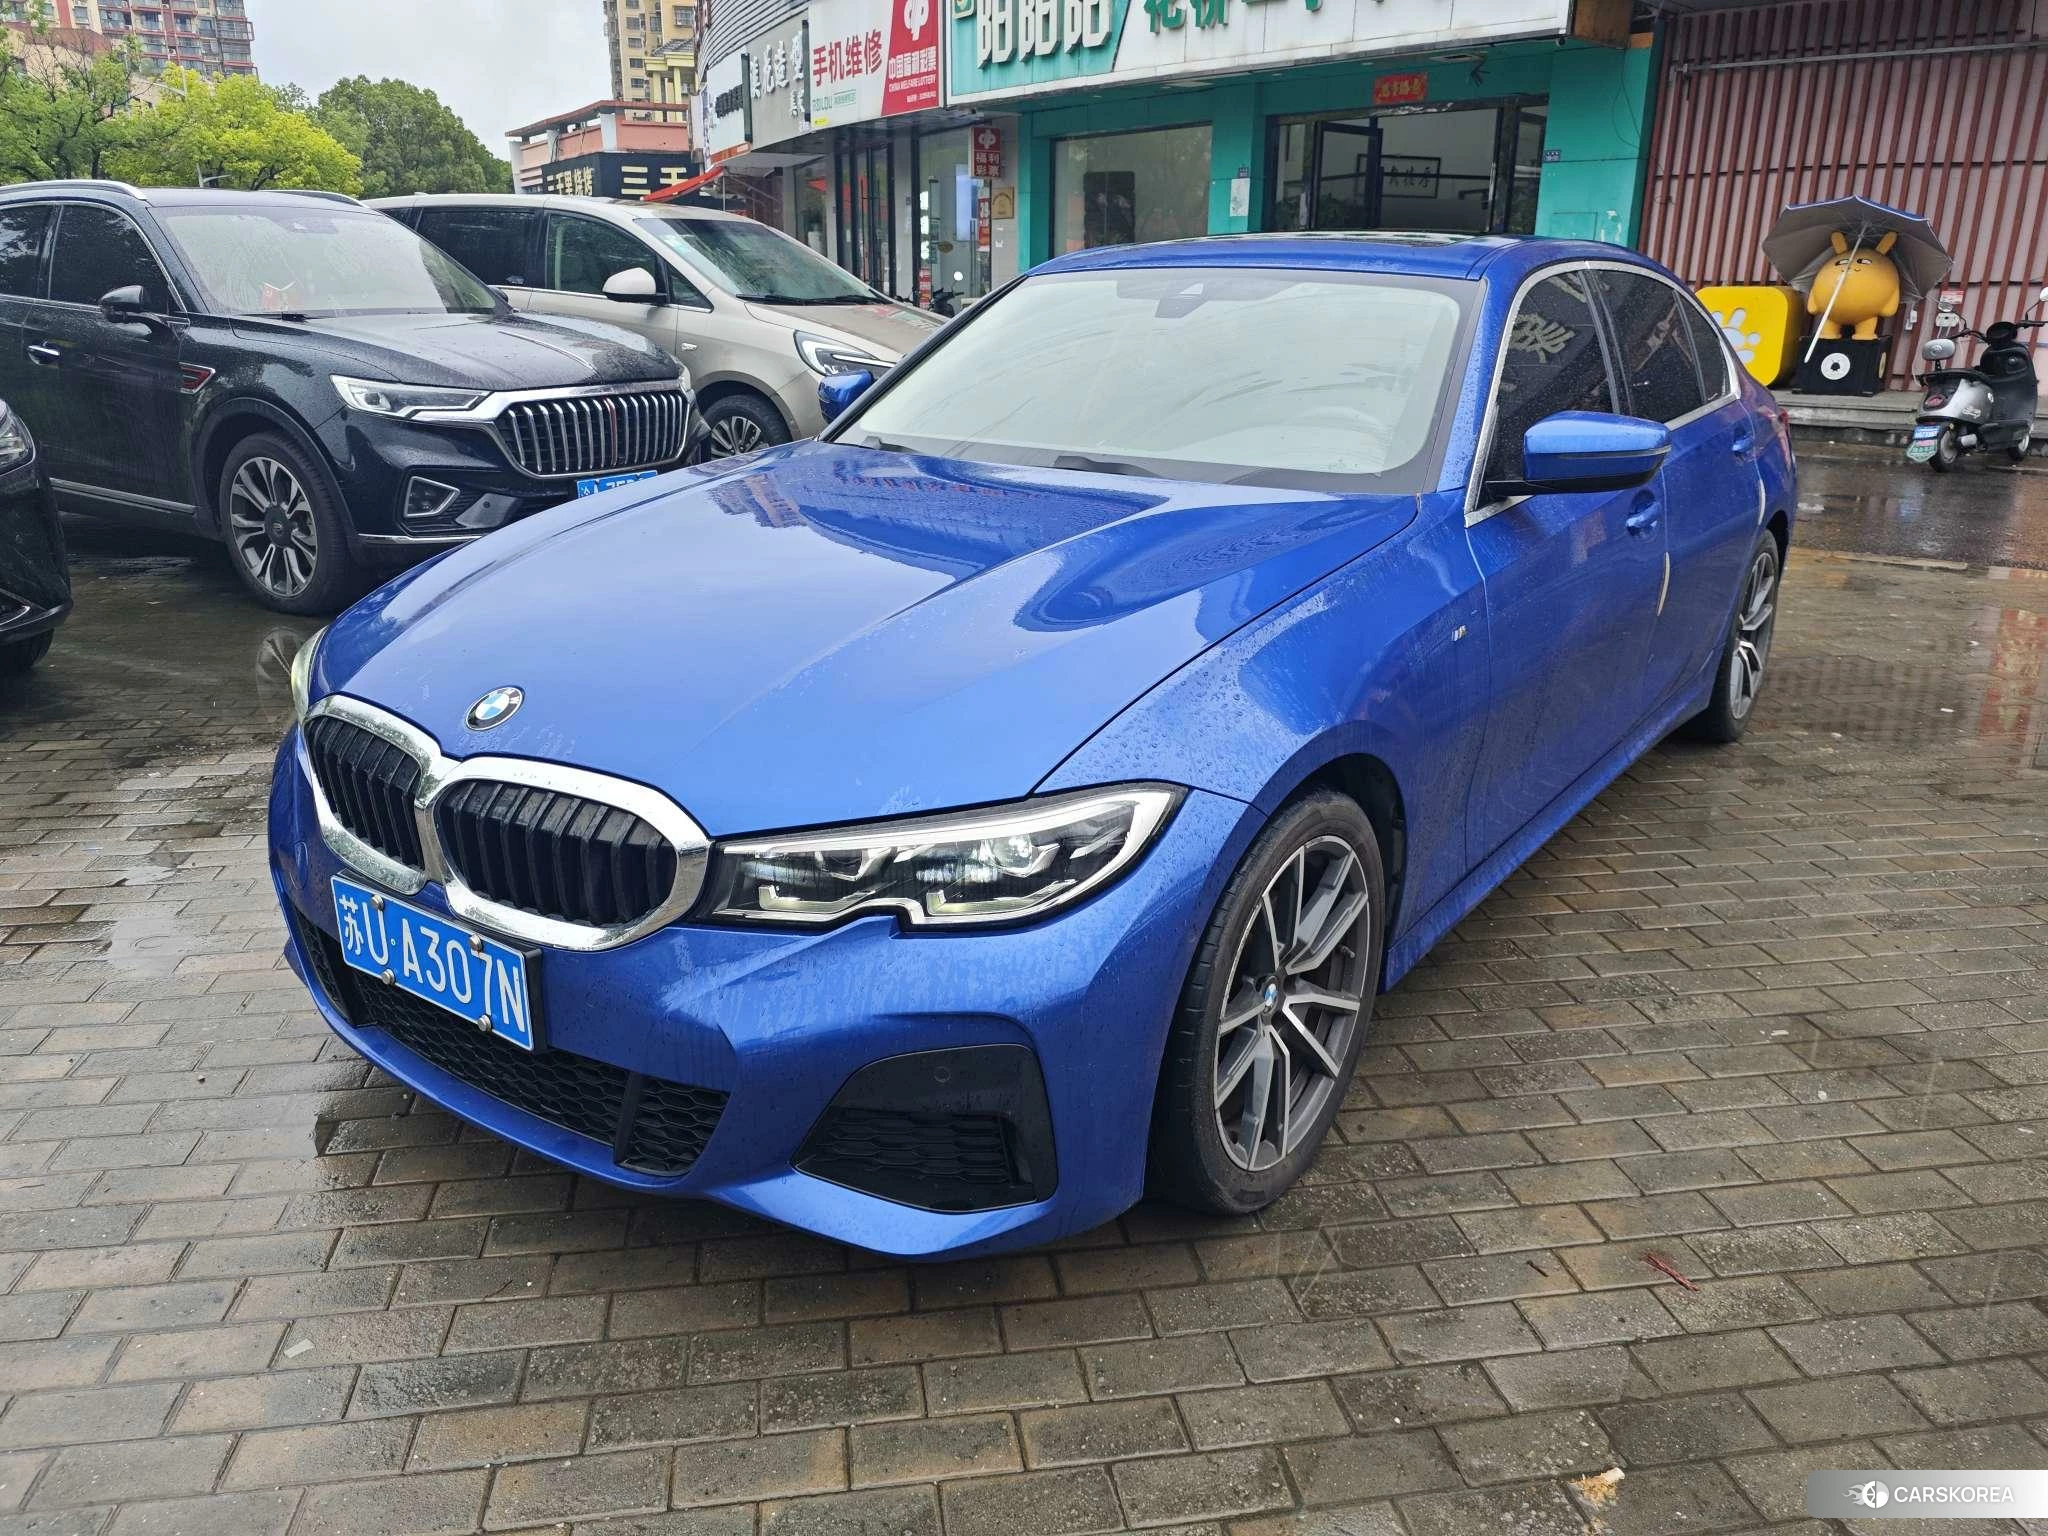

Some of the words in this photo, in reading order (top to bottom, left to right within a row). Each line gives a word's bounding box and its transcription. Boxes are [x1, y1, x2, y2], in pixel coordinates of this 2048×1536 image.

[813, 29, 882, 87] 手机维修
[888, 46, 937, 80] 中国福利彩票
[976, 152, 1000, 164] 福利
[976, 165, 1000, 177] 彩票
